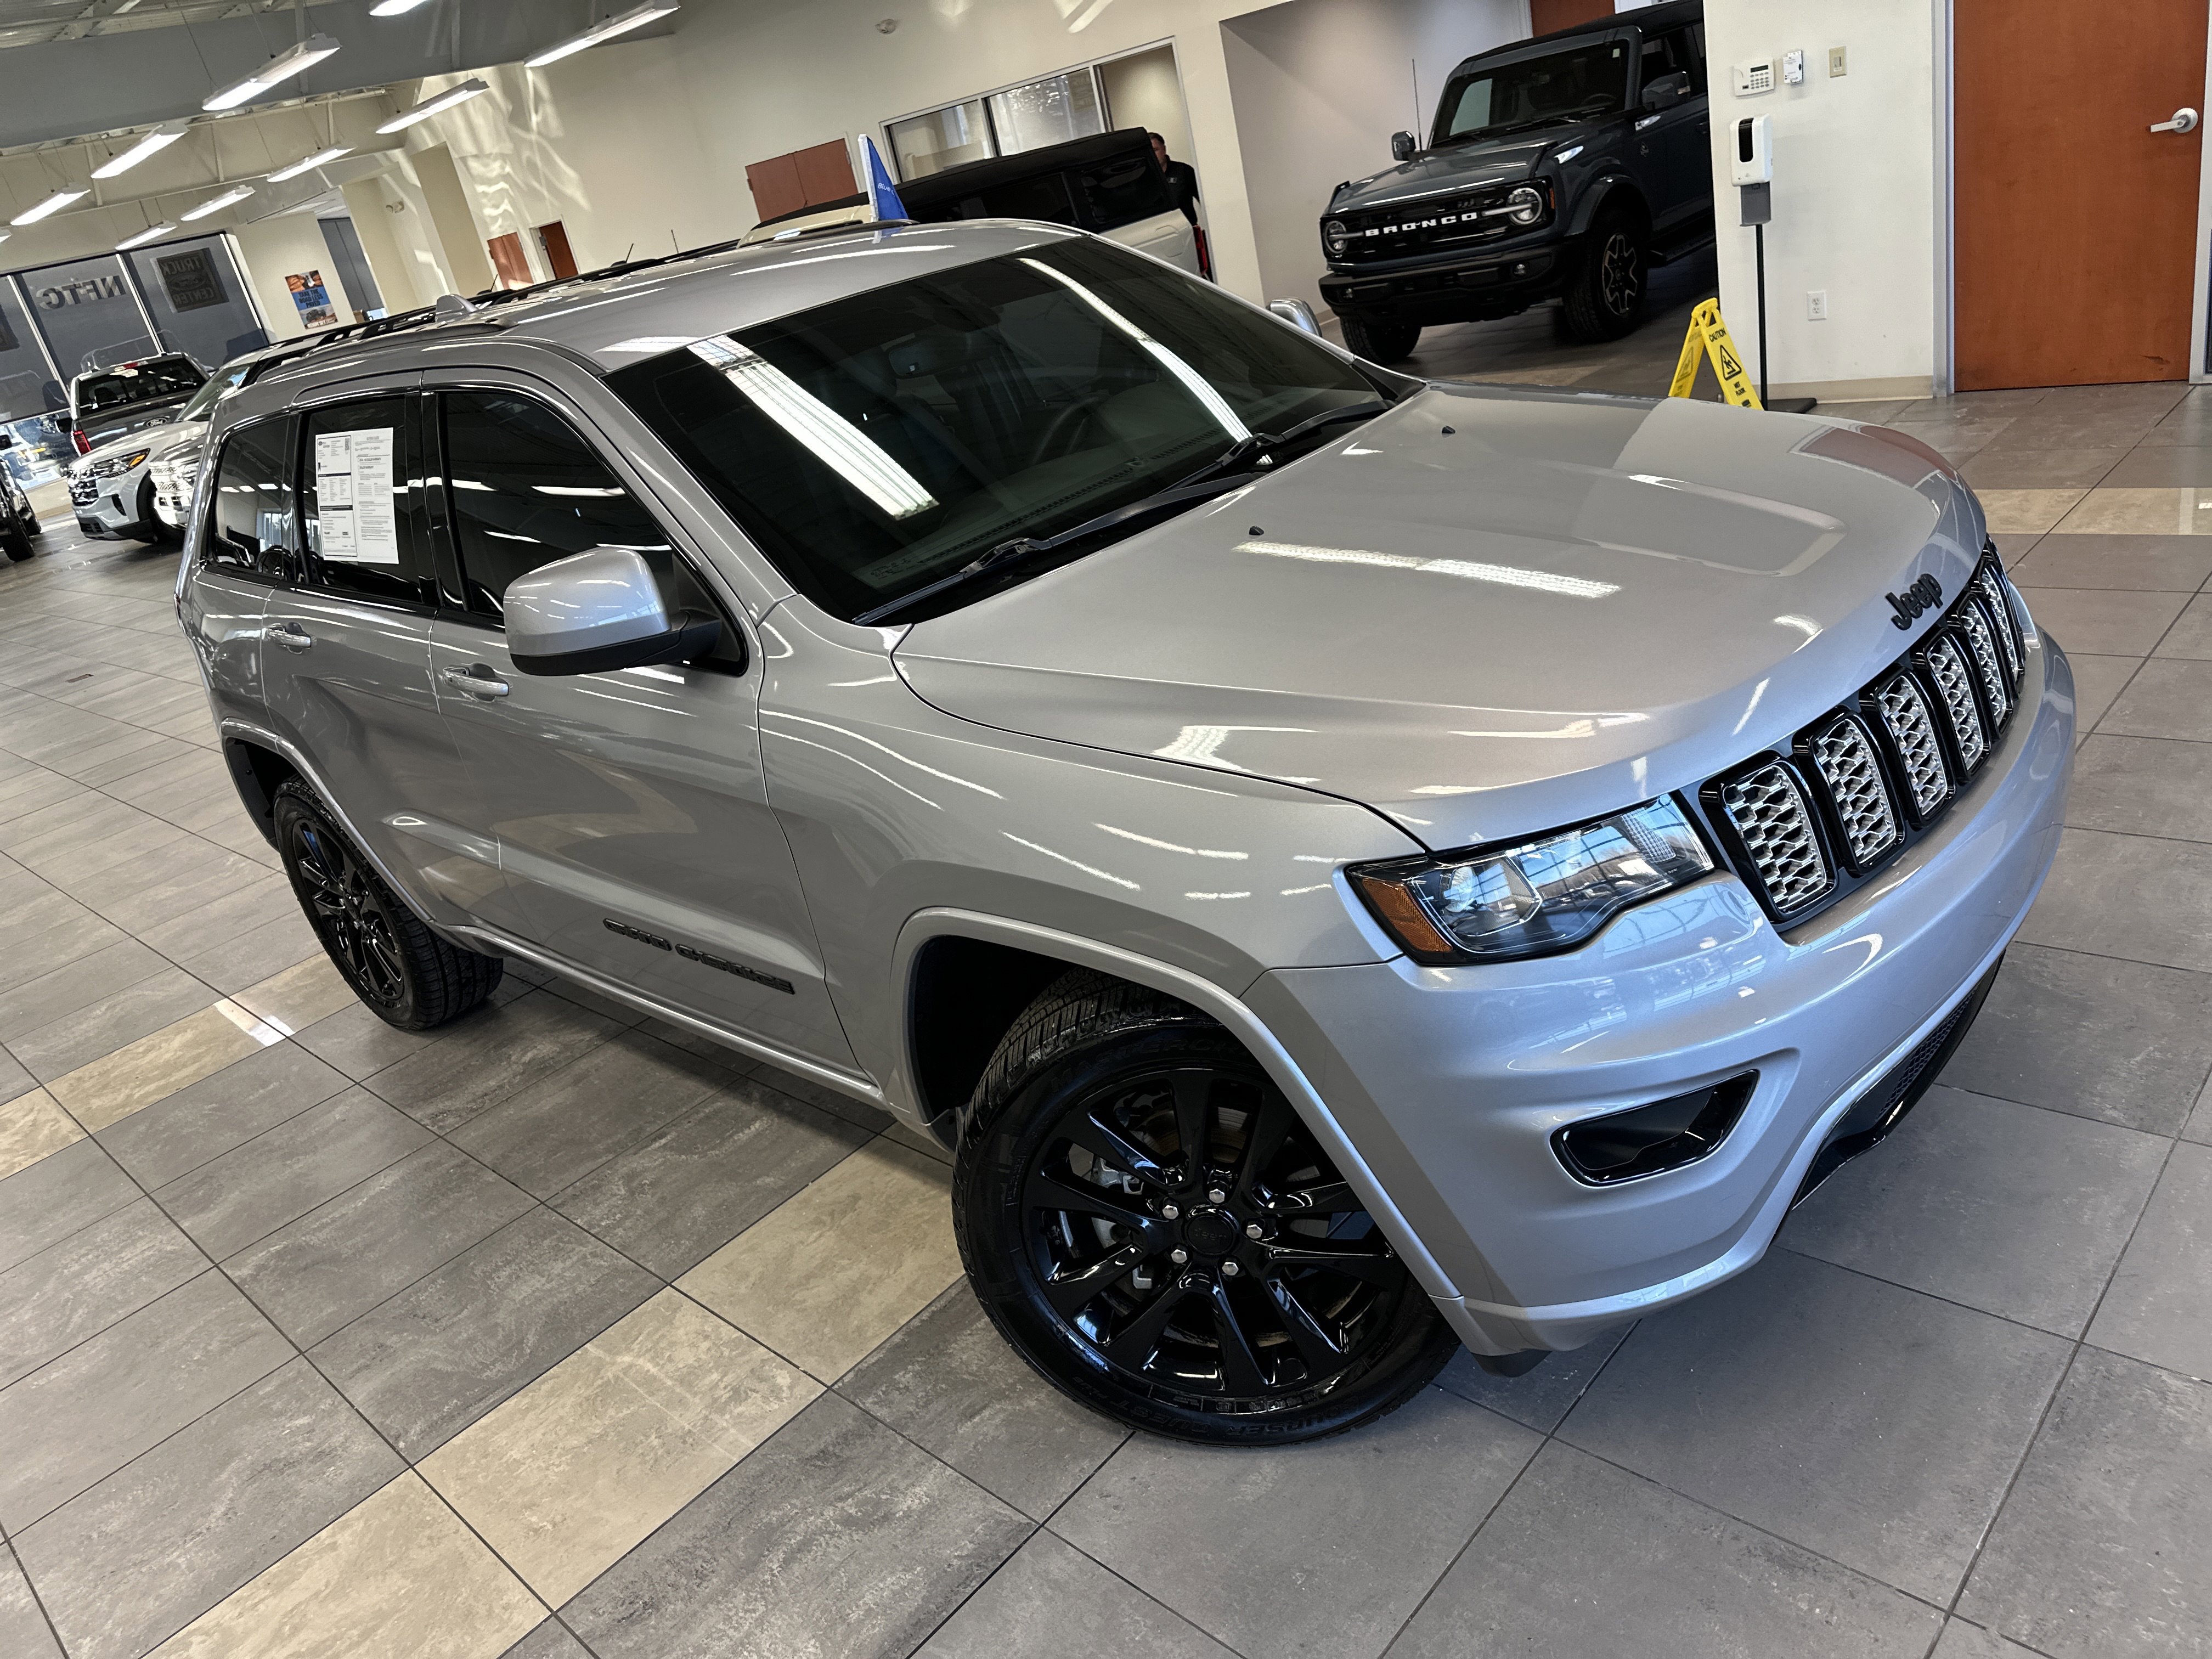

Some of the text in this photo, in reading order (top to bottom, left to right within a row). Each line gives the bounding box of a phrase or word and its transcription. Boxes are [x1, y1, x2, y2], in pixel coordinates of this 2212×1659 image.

[877, 182, 891, 192] Blue
[1365, 212, 1477, 236] BRONCO
[1709, 328, 1726, 342] CAUTION
[1884, 573, 1943, 630] Jeep
[602, 918, 673, 951] GRAND
